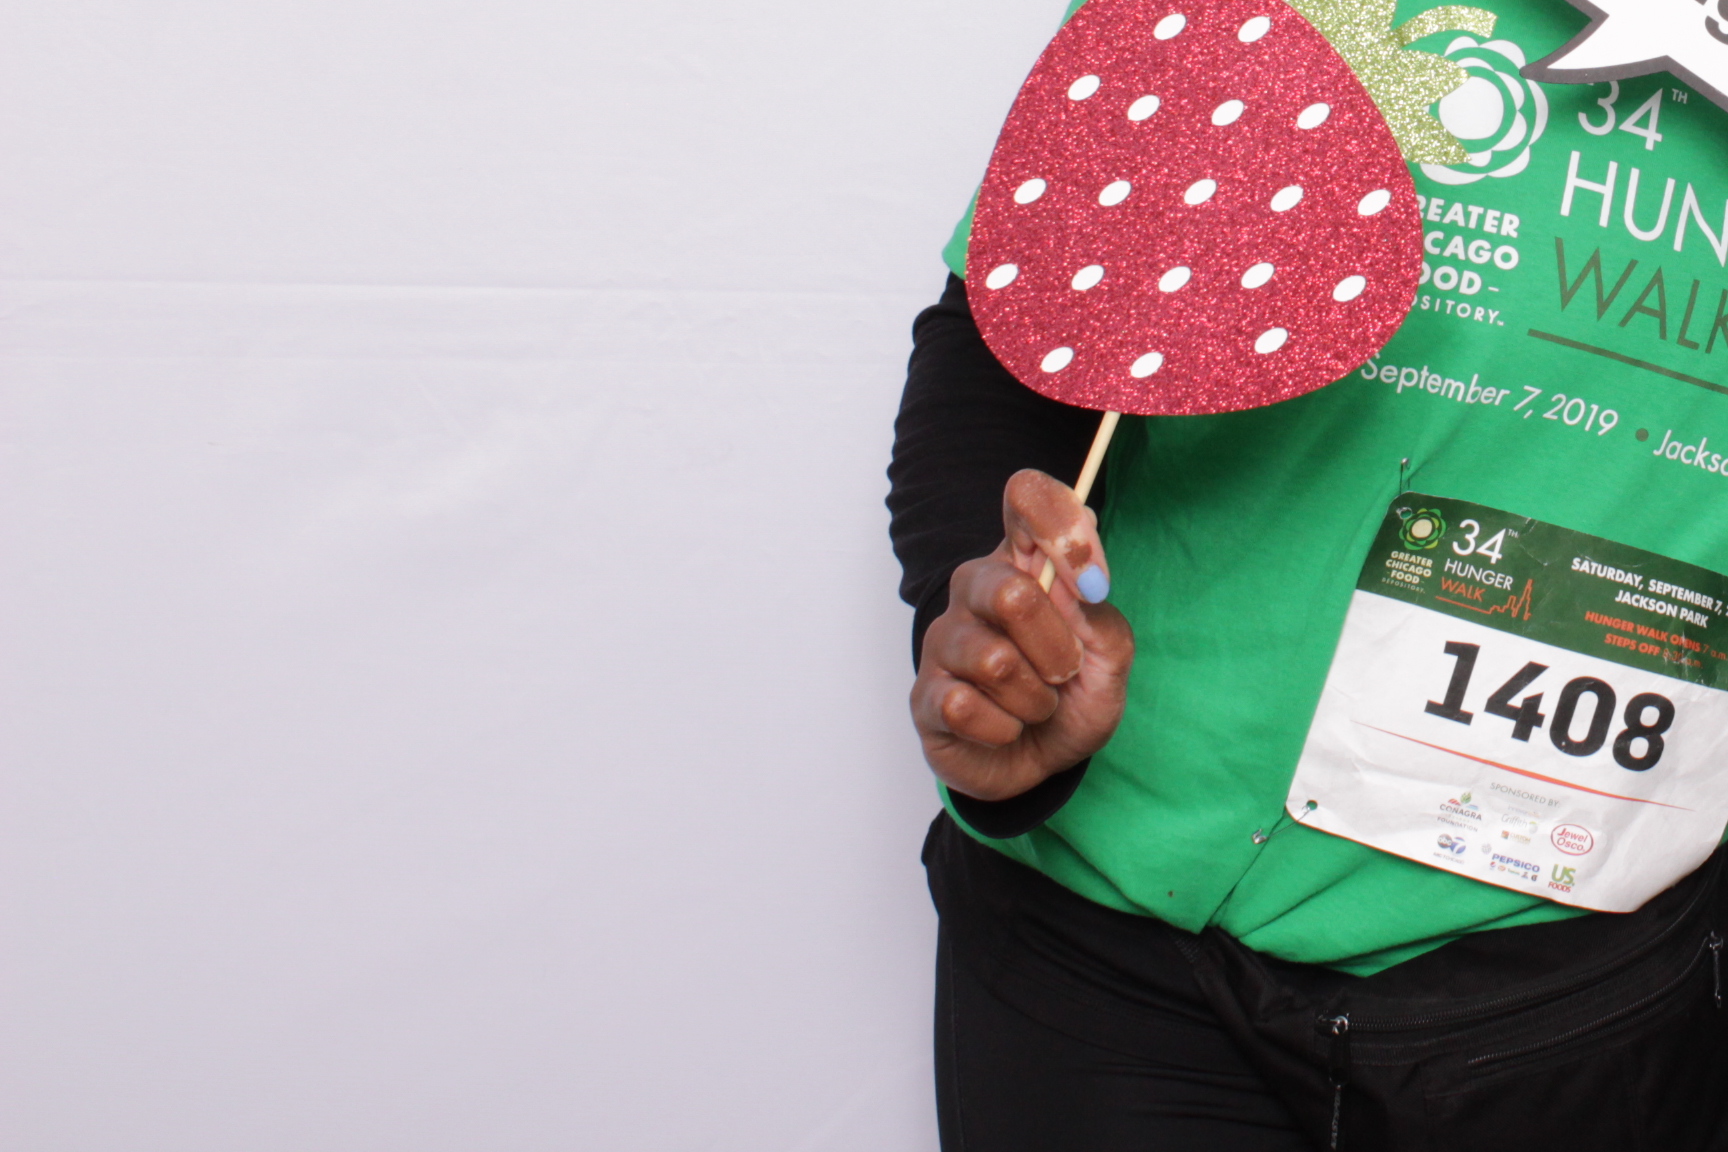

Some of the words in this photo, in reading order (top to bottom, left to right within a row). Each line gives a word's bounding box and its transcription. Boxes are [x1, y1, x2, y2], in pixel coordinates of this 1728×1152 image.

[1416, 194, 1520, 238] REATER
[1424, 230, 1519, 270] CAGO
[1411, 294, 1500, 325] SITORY
[1361, 352, 1510, 406] September
[1513, 385, 1542, 419] 7,
[1543, 393, 1619, 436] 2019
[1386, 559, 1432, 578] CHICAGO
[1391, 551, 1433, 568] GREATER
[1444, 558, 1514, 590] HUNGER
[1571, 557, 1645, 590] SATURDAY,
[1648, 579, 1713, 610] SEPTEMBER
[1714, 600, 1723, 615] 7,
[1441, 577, 1486, 602] WALK
[1615, 590, 1678, 618] JACKSON
[1679, 608, 1709, 628] PARK
[1584, 611, 1635, 633] HUNGER
[1636, 624, 1669, 643] WALK
[1604, 633, 1637, 651] STEPS
[1638, 643, 1661, 657] OFF
[1424, 640, 1676, 772] 1408
[1490, 782, 1547, 804] SPONSORED
[1439, 803, 1482, 821] CONAGRA
[1557, 828, 1588, 843] Jewel
[1491, 853, 1540, 873] PEPSICO
[1548, 881, 1572, 893] FOODS
